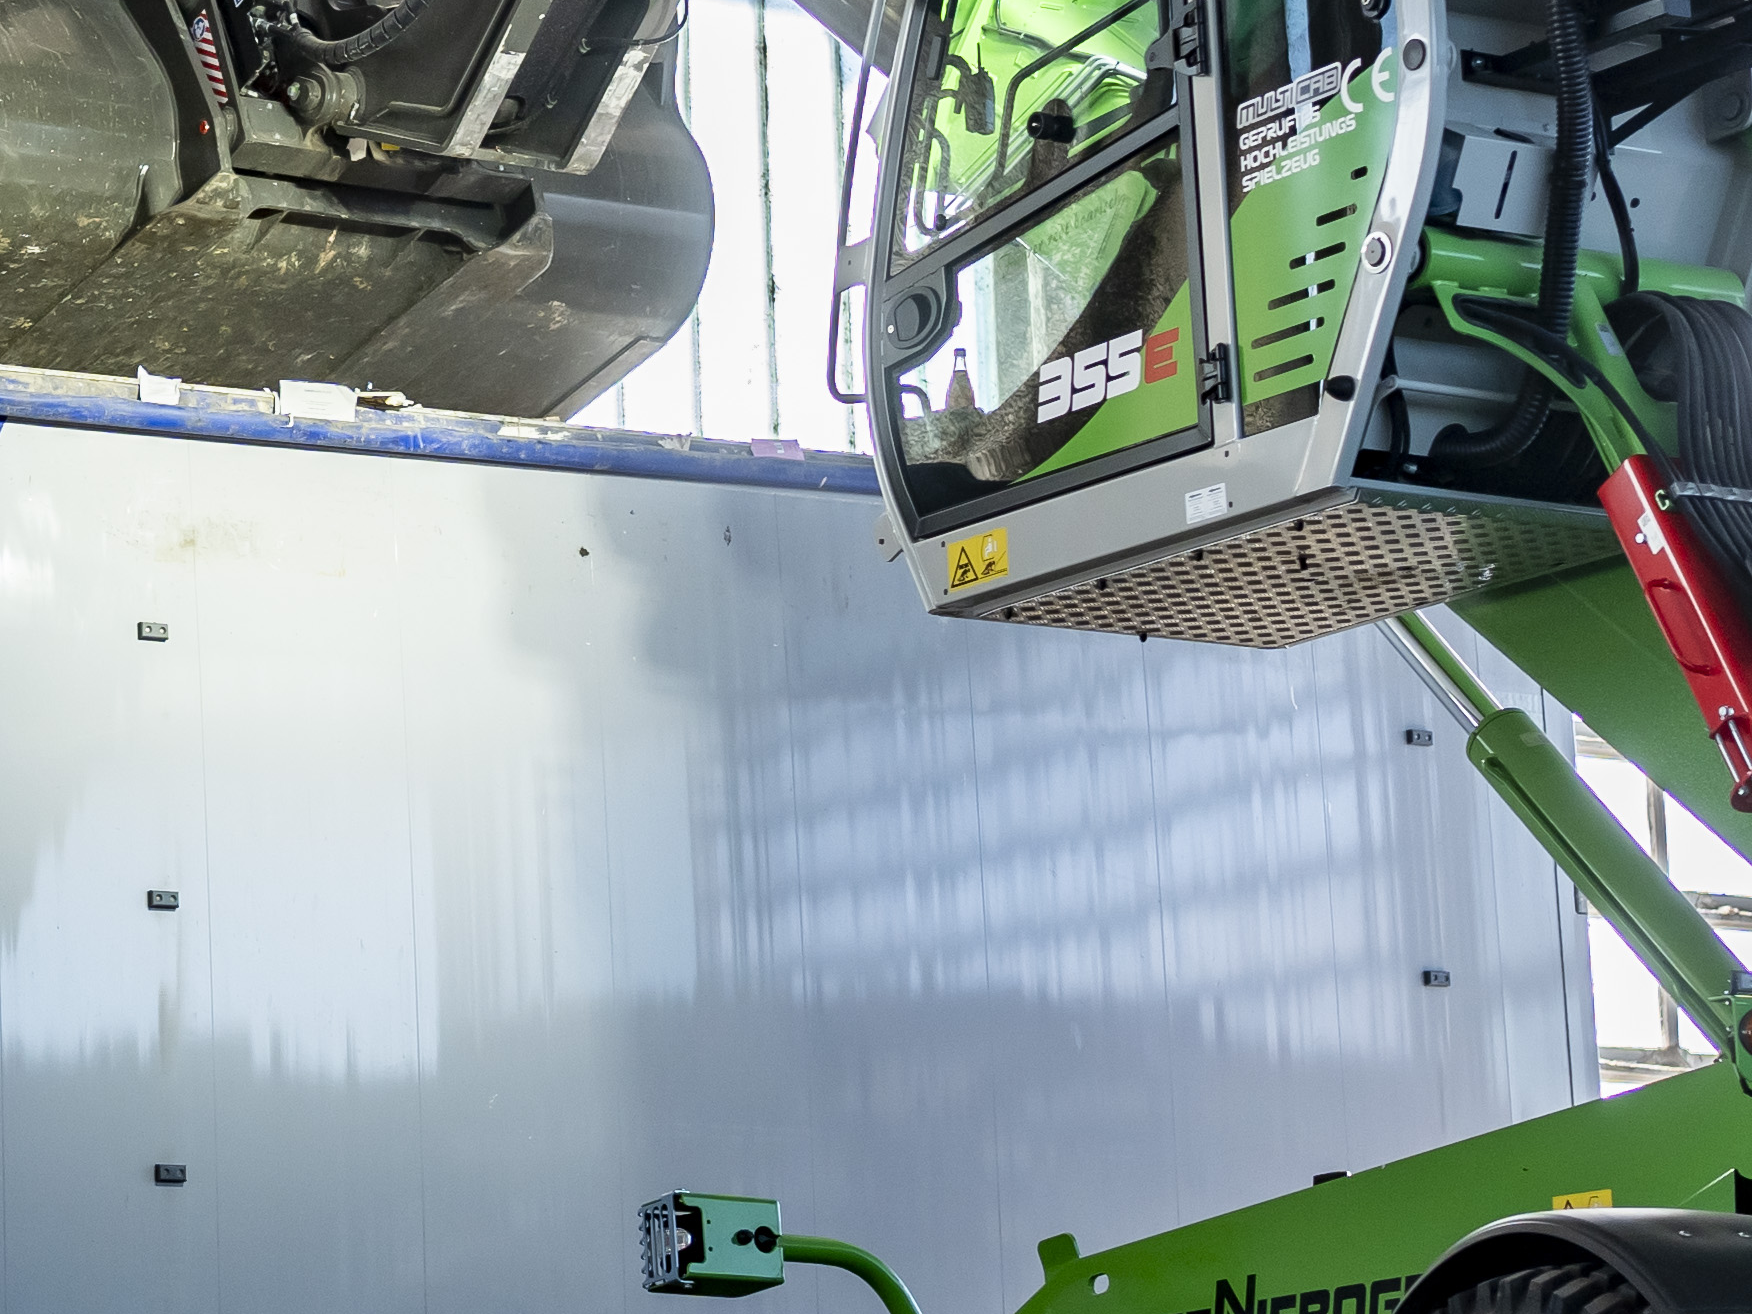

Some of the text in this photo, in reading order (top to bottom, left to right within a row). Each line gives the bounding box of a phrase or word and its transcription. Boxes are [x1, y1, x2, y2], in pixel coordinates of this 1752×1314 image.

[1240, 114, 1356, 172] HOCHLEISTUNGS
[1241, 148, 1320, 192] SPIELZEUG
[1037, 326, 1180, 424] 355E
